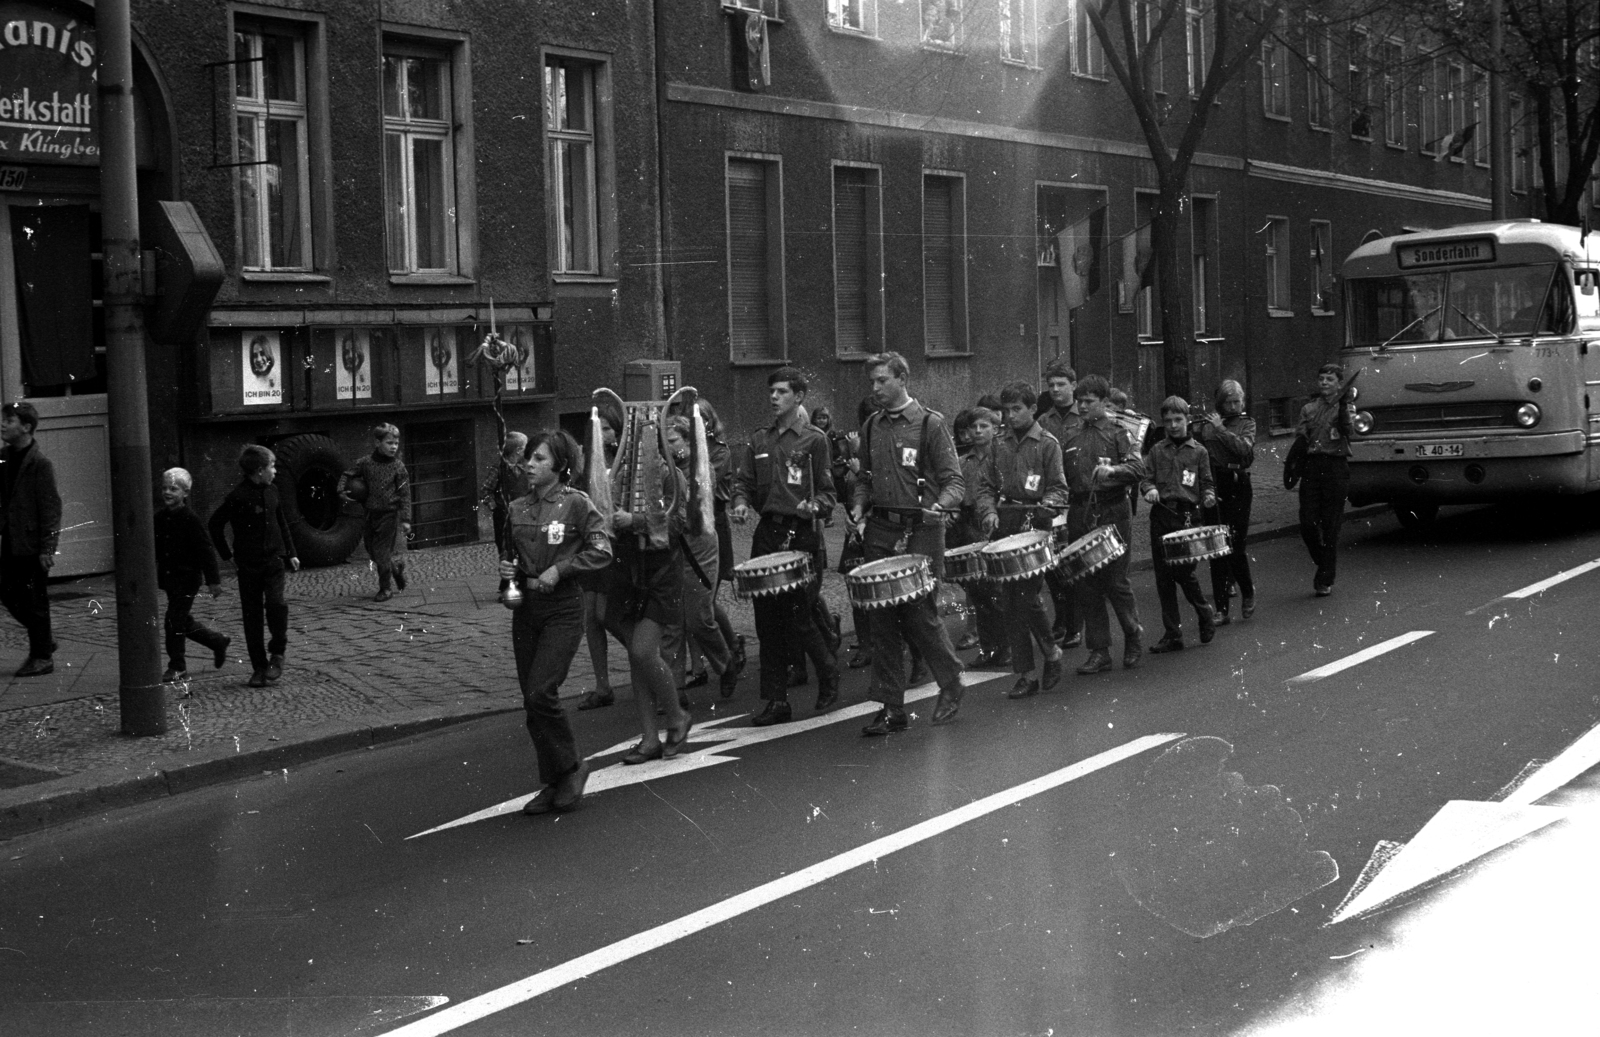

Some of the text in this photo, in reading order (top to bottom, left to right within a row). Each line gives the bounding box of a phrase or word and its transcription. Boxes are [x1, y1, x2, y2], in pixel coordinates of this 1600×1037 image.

[0, 87, 91, 124] erkstatt
[0, 169, 25, 188] 150
[1414, 244, 1479, 263] Sonderfahrt
[245, 389, 281, 398] ICH BIN 20
[338, 385, 349, 393] ICH
[362, 384, 371, 392] 20
